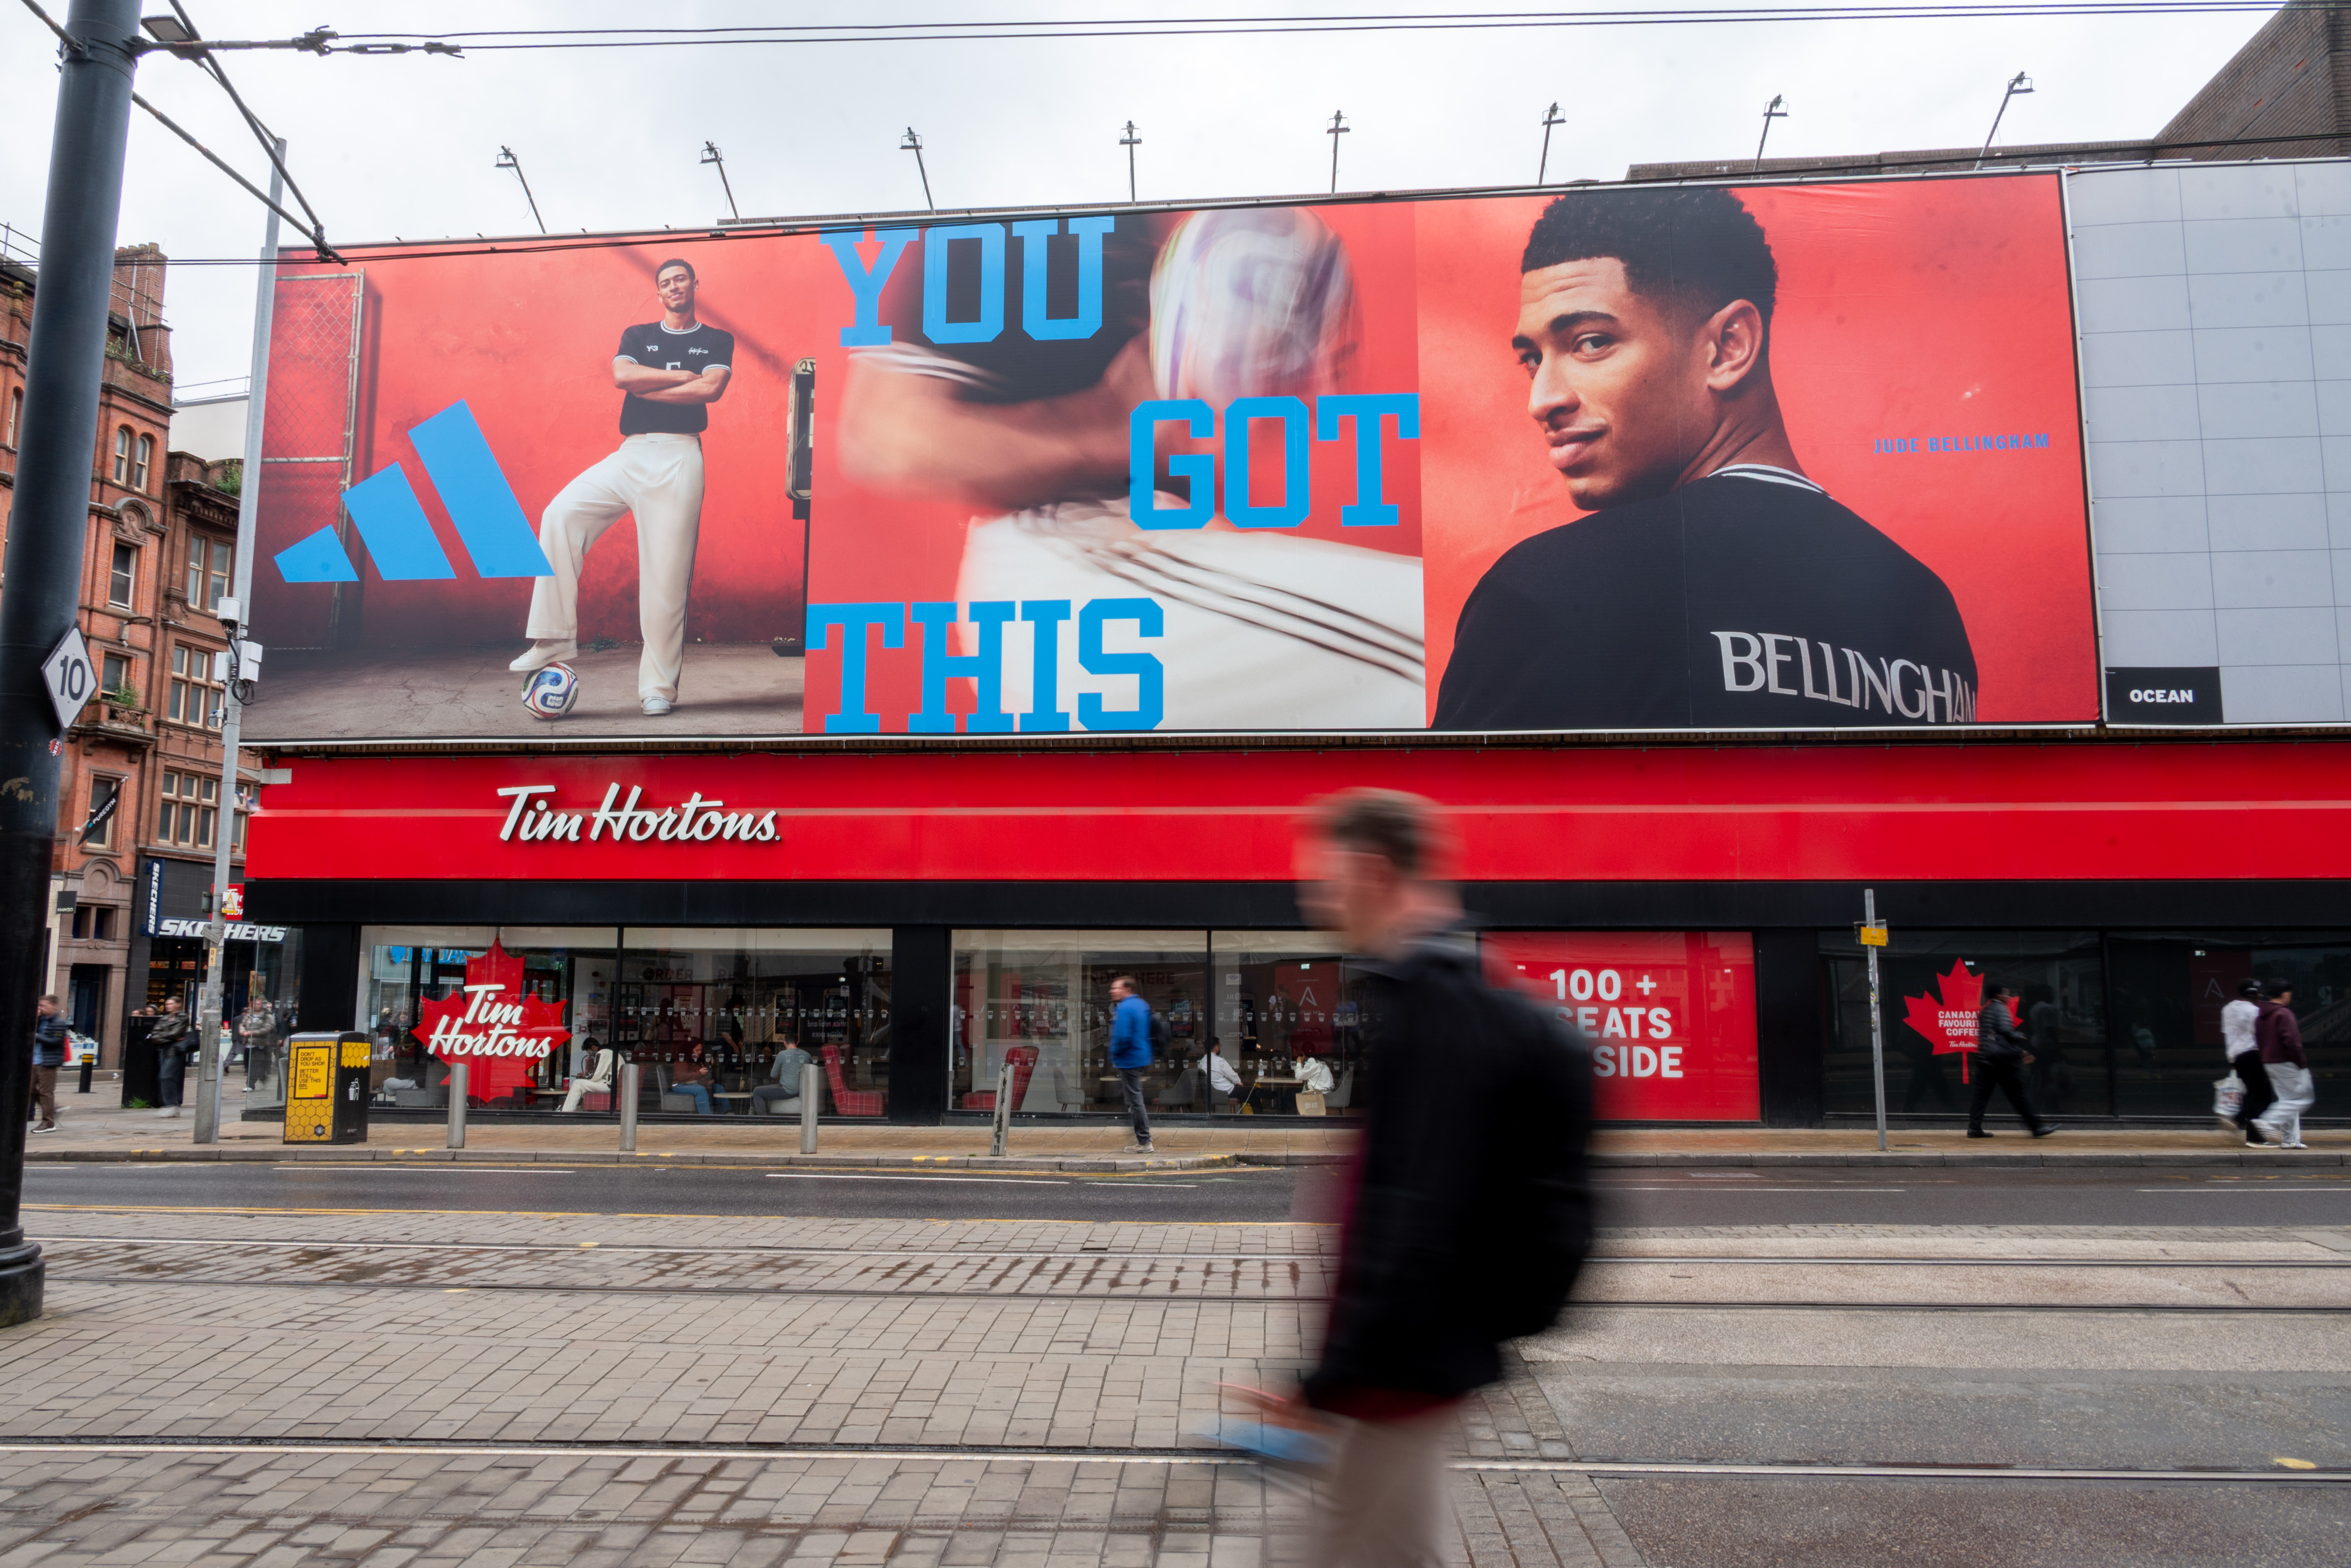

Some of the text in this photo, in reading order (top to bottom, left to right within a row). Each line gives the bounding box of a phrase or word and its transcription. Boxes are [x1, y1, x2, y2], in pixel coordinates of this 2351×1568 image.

[820, 216, 1114, 347] YOU
[1130, 393, 1419, 530] GOT
[1874, 433, 2048, 454] JUDE BELLINGHAM
[60, 655, 86, 701] 10
[806, 598, 1163, 733] THIS
[2129, 689, 2193, 702] OCEAN
[92, 798, 116, 824] PUREGYM
[497, 782, 777, 842] Tim Hortons
[148, 862, 160, 935] SKECHERS
[159, 919, 287, 942] SKEHERS
[1550, 969, 1621, 1001] 100
[463, 984, 524, 1025] Tim
[1938, 1010, 1979, 1019] CANADA'
[427, 1014, 552, 1058] Hortons
[1938, 1019, 1980, 1028] FAVOURIT
[1593, 1045, 1683, 1078] SIDE
